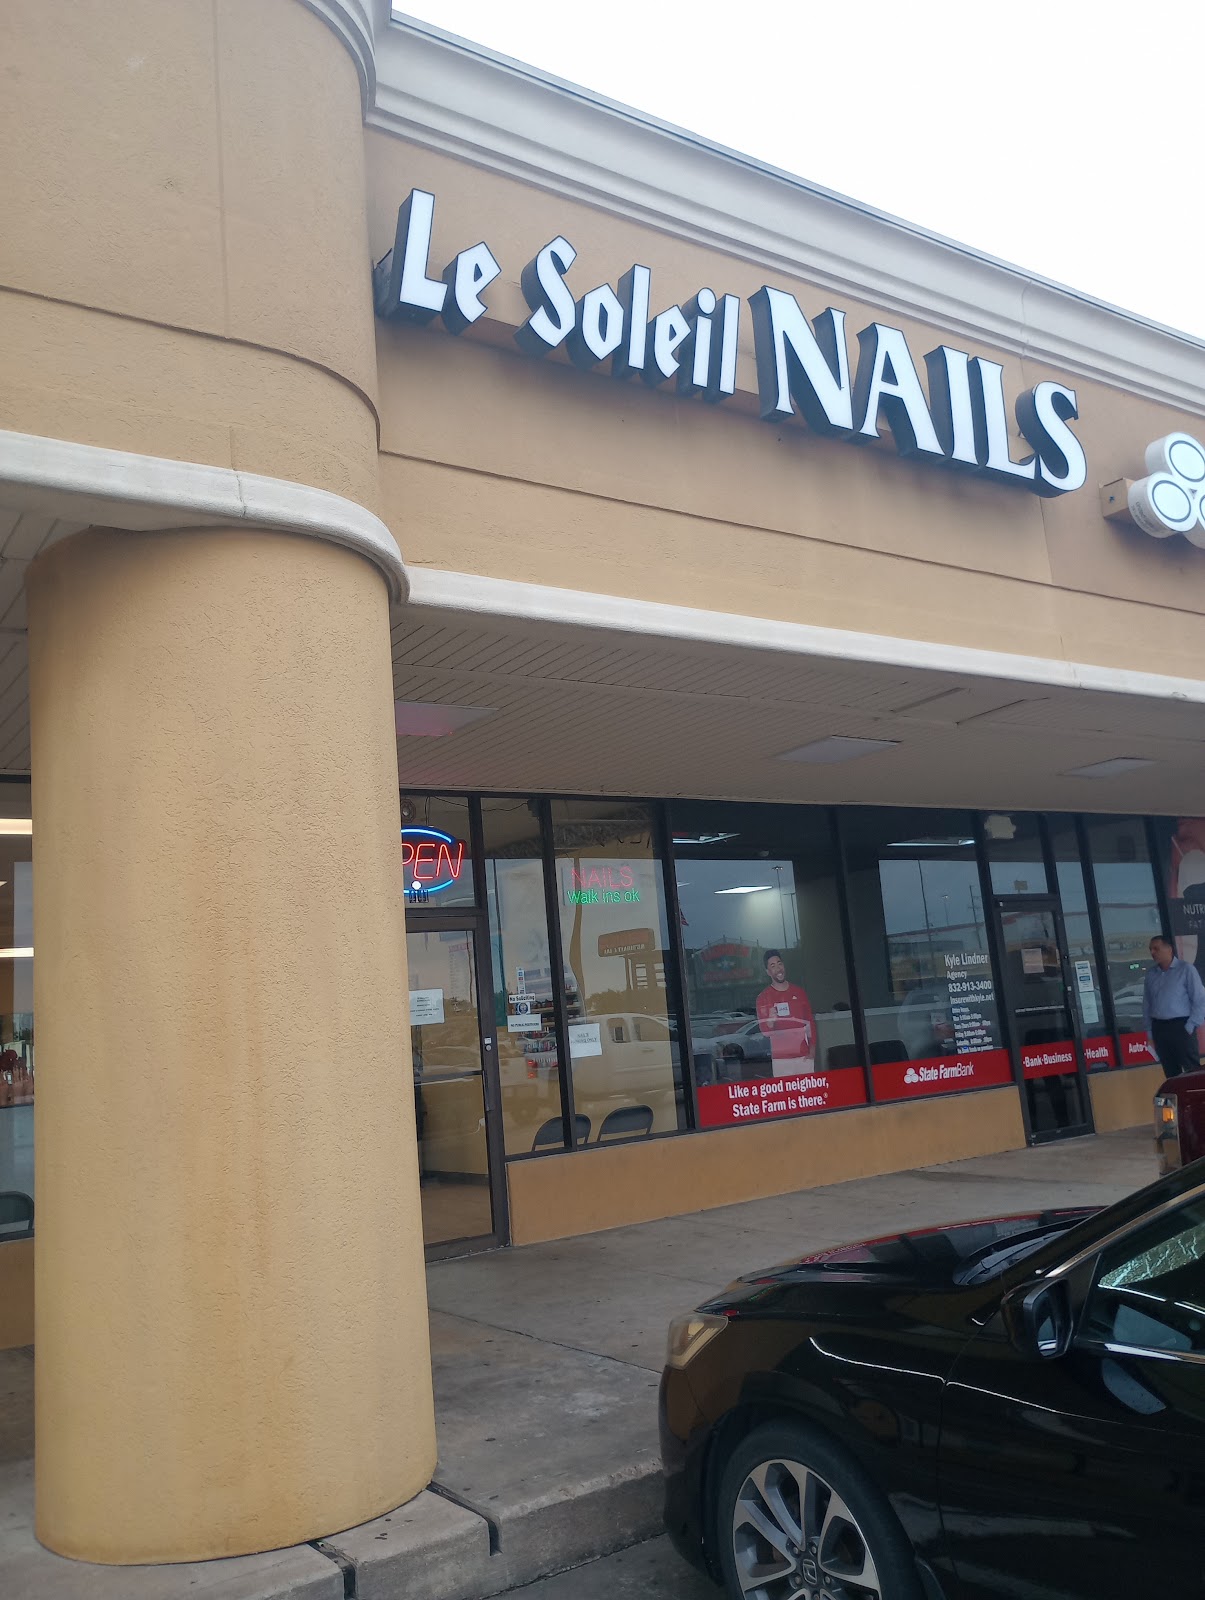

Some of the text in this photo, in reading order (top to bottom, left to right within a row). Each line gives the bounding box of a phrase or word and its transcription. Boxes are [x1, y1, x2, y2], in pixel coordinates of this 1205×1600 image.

[399, 188, 1088, 492] Le Soleil NAILS
[401, 842, 464, 880] PEN
[571, 865, 635, 888] NAILS
[1183, 903, 1205, 915] NUTR
[944, 953, 988, 969] Kyle Lindner
[947, 971, 967, 980] Agency
[948, 981, 992, 993] 832-913-3400
[919, 1066, 938, 1082] State
[728, 1076, 829, 1099] Like a good neighbor,
[732, 1102, 760, 1117] State
[762, 1096, 786, 1113] Farm
[787, 1097, 797, 1109] is
